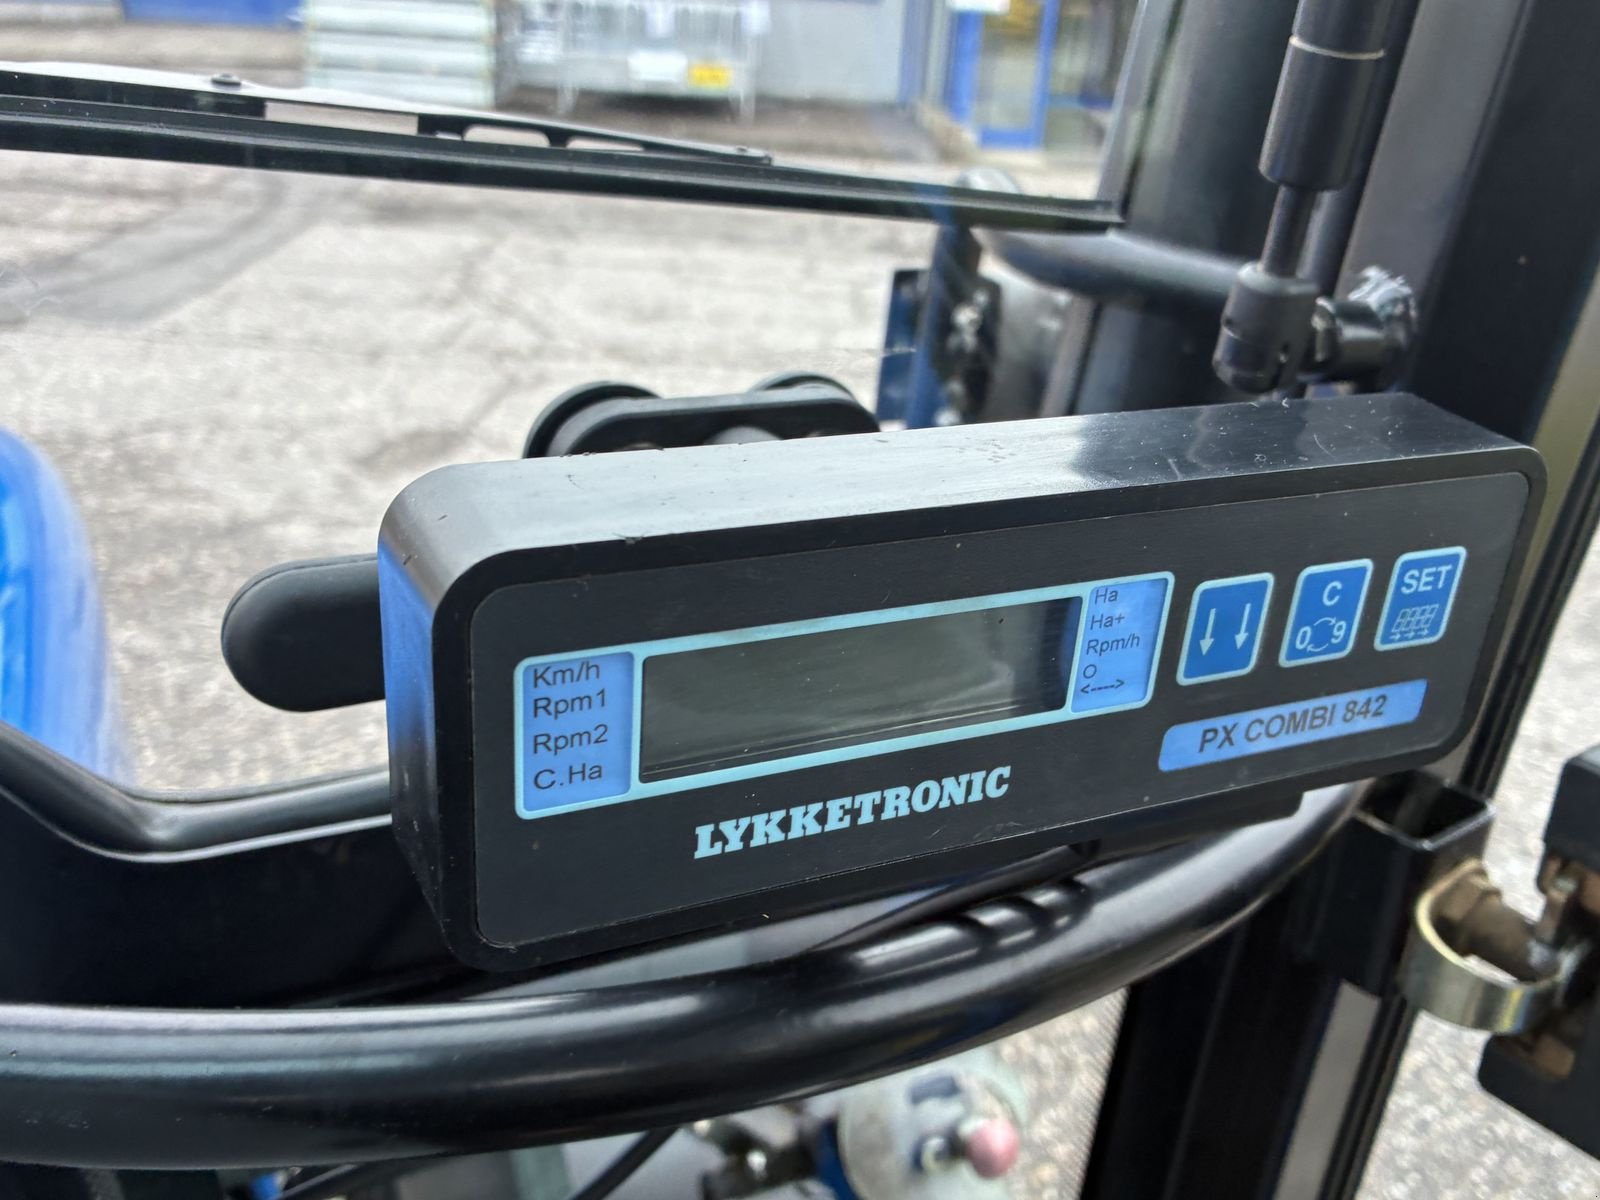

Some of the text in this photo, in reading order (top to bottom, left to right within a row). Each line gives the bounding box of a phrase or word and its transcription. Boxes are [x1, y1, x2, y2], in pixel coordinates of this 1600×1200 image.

[1322, 581, 1344, 607] C
[1400, 564, 1452, 595] SET
[1094, 588, 1118, 604] Ha
[1090, 613, 1125, 630] Ha+
[1295, 620, 1347, 650] 0 9
[1086, 633, 1140, 656] Rpm/h
[533, 661, 600, 689] Km/h
[532, 688, 607, 720] Rpm1
[1198, 694, 1388, 753] PX COMBI 842
[532, 723, 608, 755] Rpm2
[533, 763, 603, 790] C.Ha
[693, 765, 1011, 860] LYKKETRONIC
